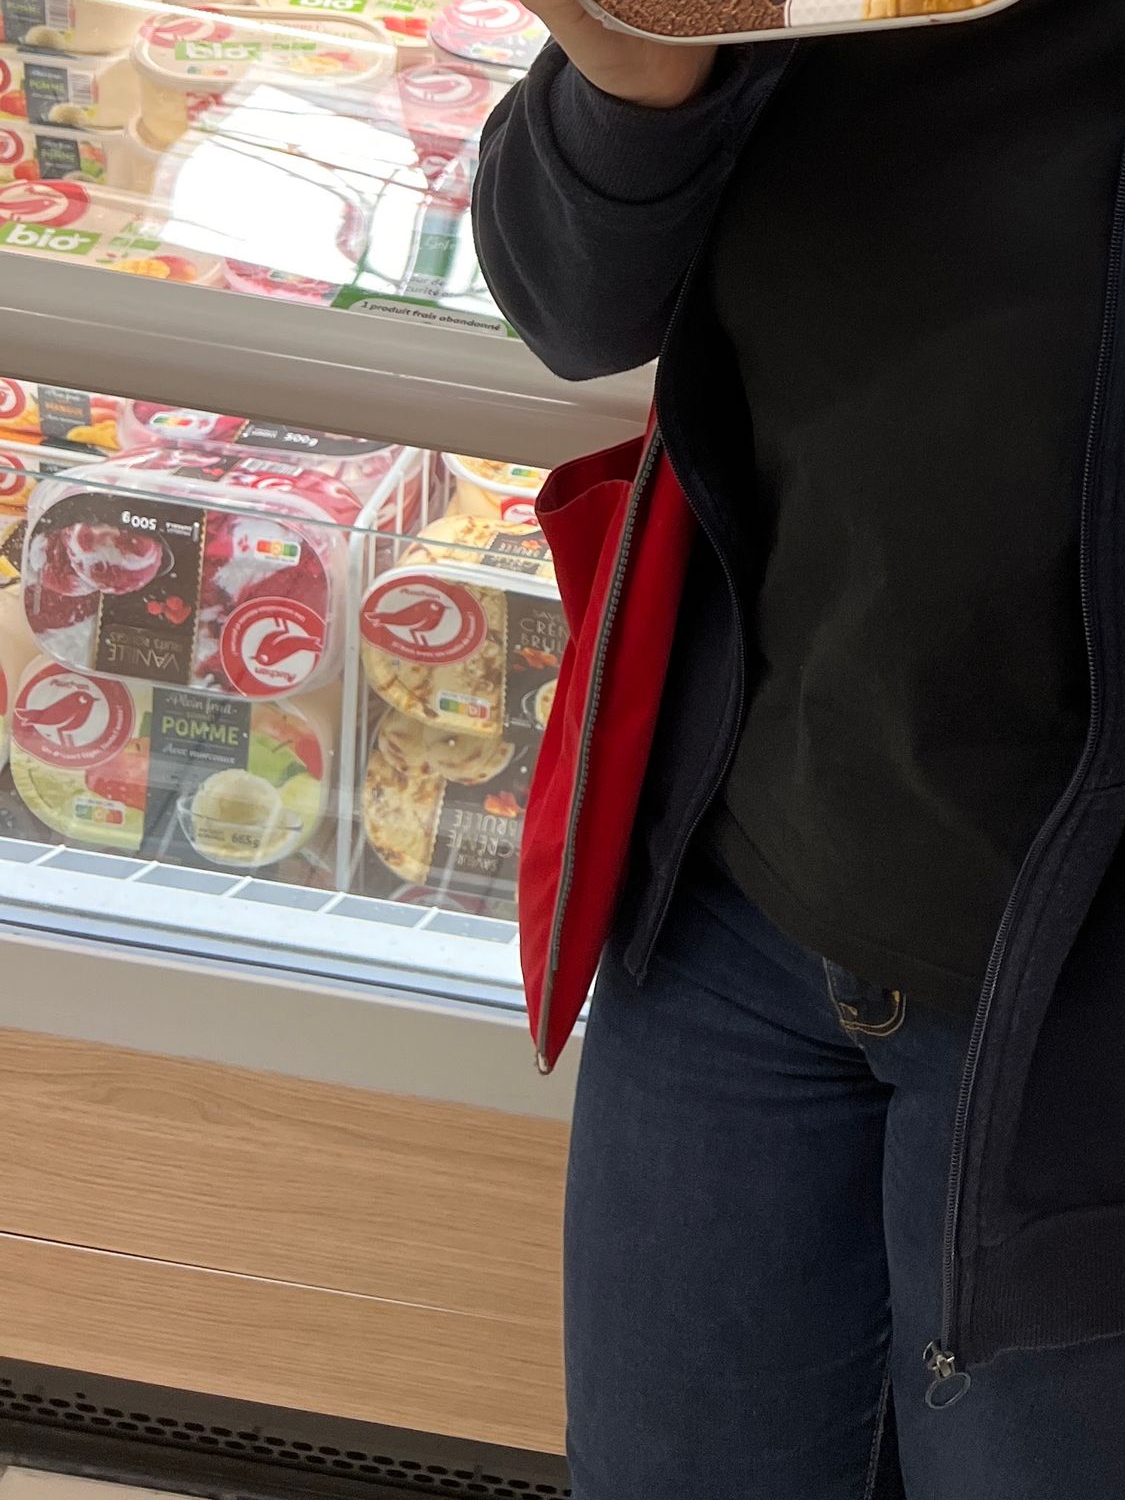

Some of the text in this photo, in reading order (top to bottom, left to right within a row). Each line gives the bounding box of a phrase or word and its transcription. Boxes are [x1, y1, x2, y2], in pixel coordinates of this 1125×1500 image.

[186, 41, 252, 60] bio
[6, 224, 84, 251] bio
[369, 303, 411, 317] produit
[412, 309, 438, 321] frais
[439, 313, 501, 331] abandonné
[107, 643, 181, 672] VANILE
[162, 716, 240, 745] POMME
